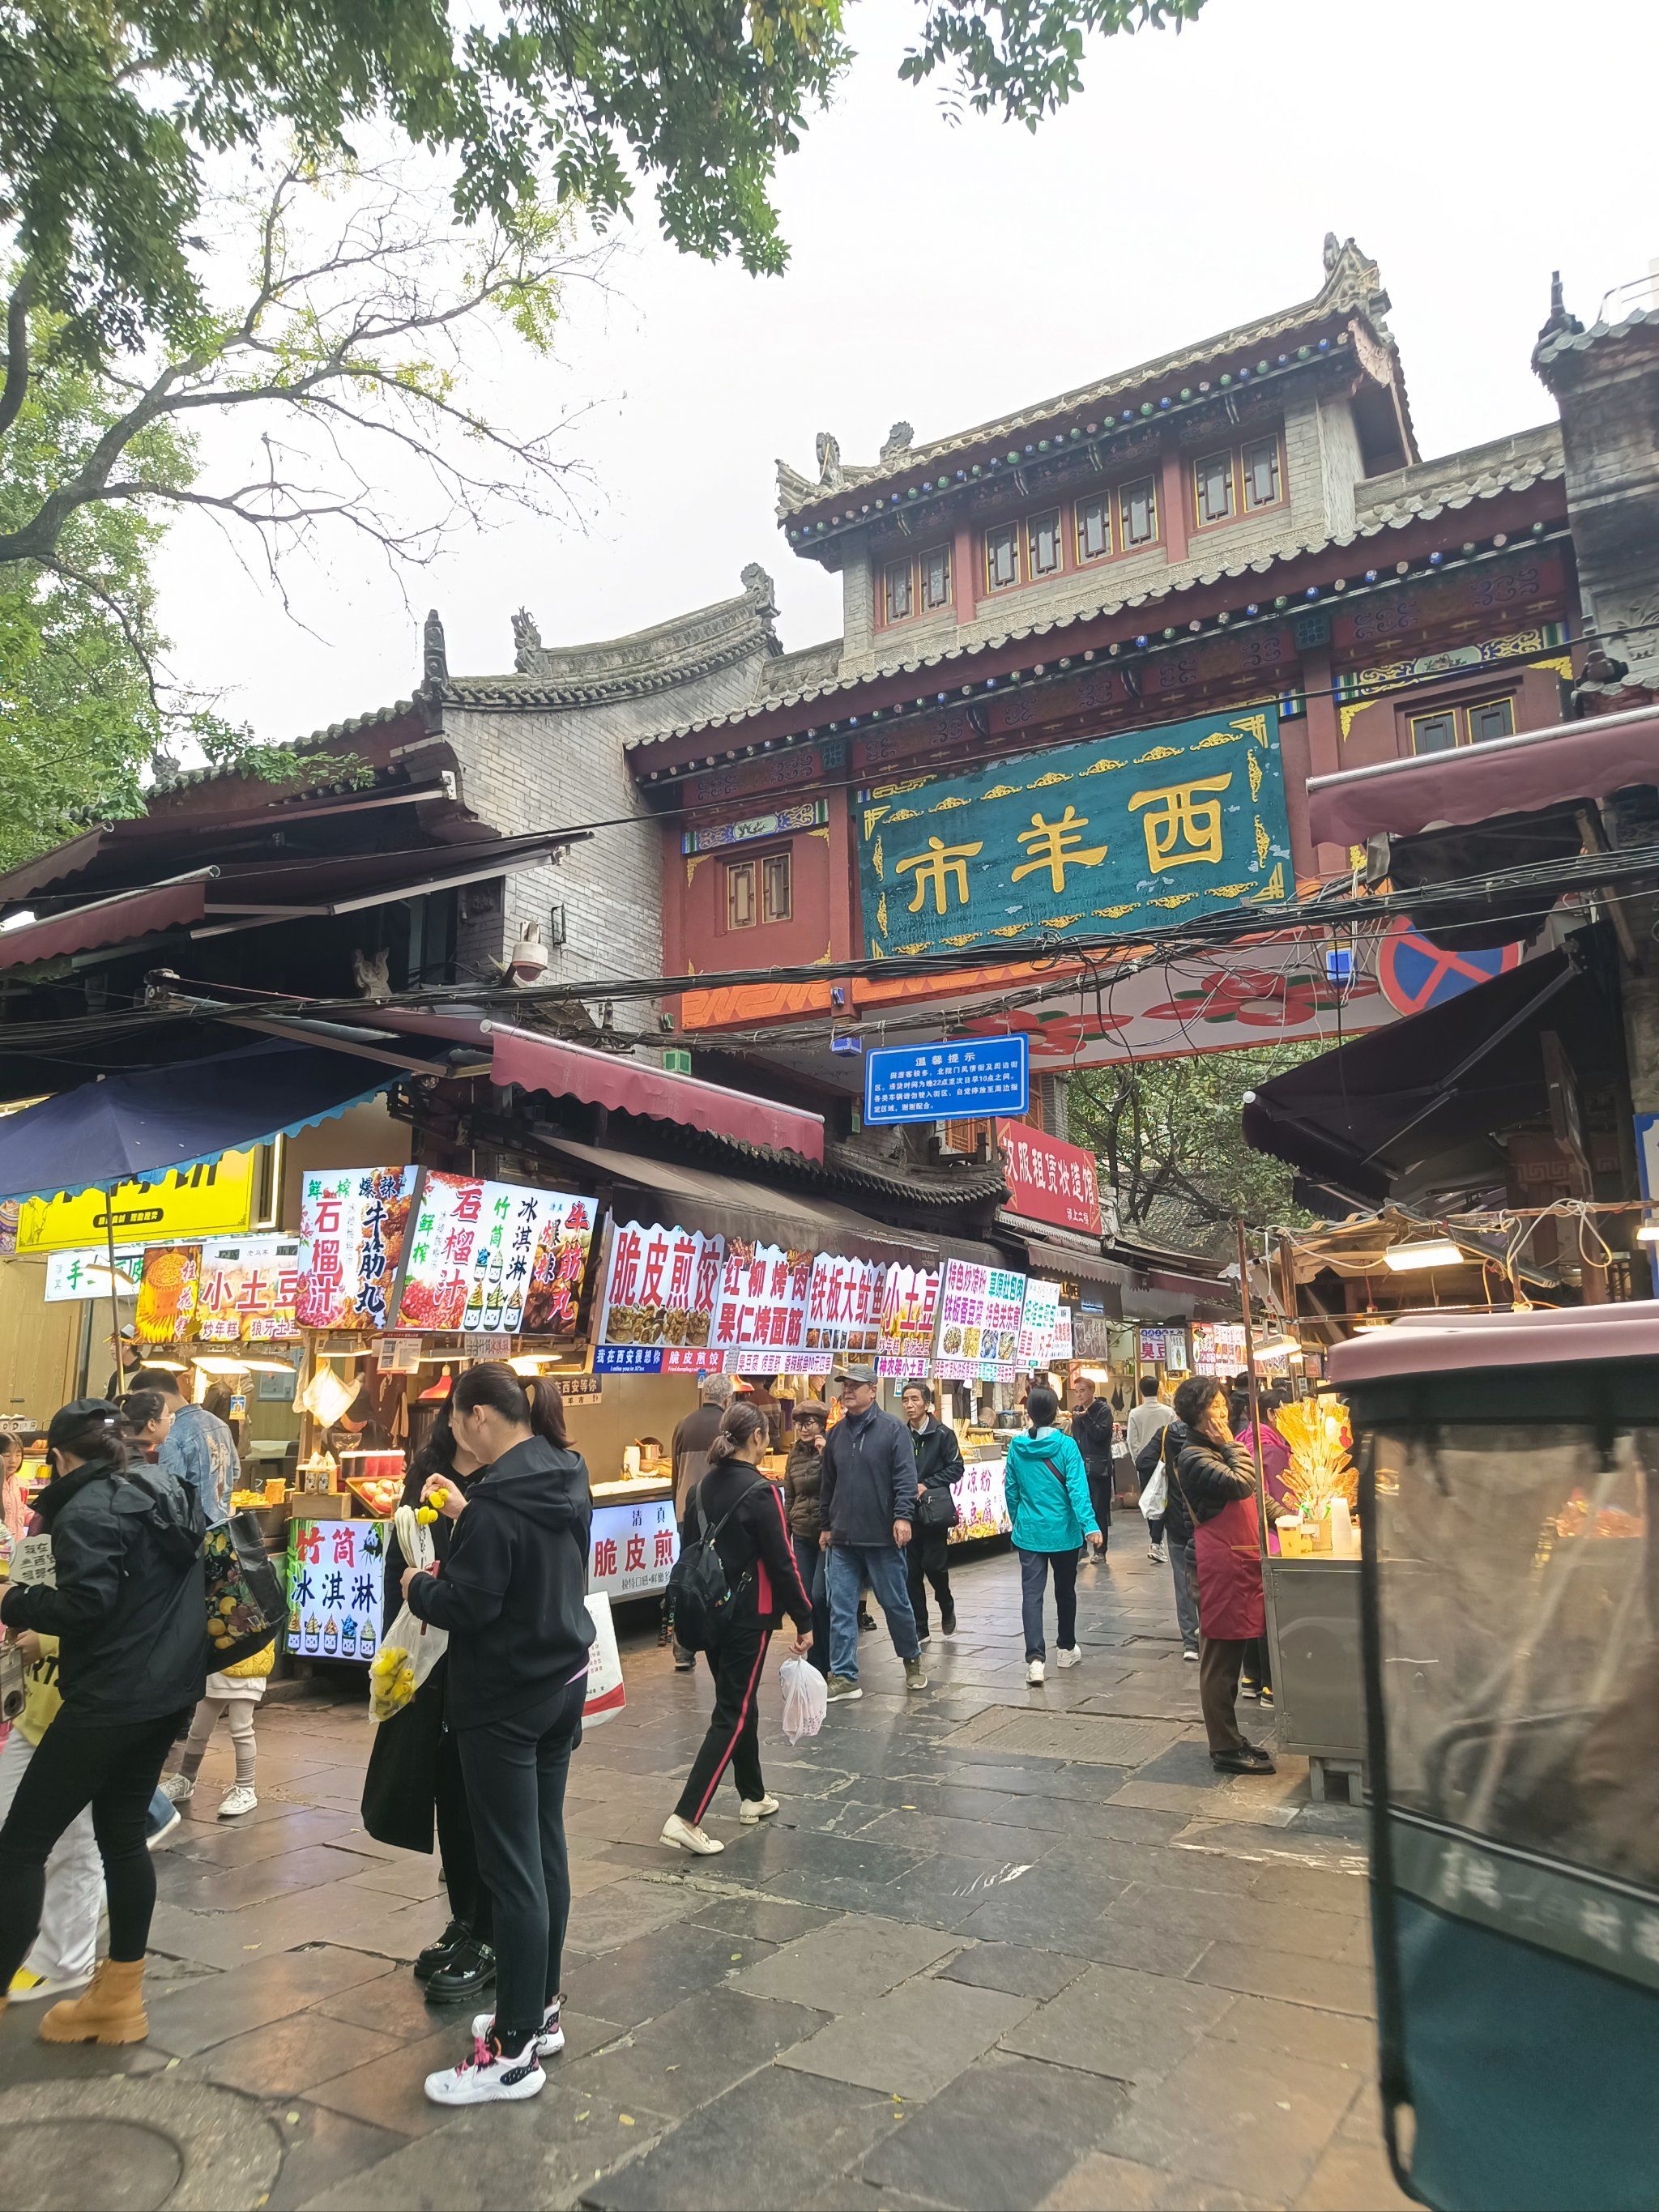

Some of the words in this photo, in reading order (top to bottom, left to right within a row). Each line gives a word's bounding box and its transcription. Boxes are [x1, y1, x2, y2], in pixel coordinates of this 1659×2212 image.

[915, 1052, 975, 1067] 温馨提示
[308, 1178, 351, 1200] 鲜榨
[359, 1176, 396, 1199] 爆辣
[412, 1213, 435, 1265] 鲜榨
[489, 1195, 510, 1248] 竹筒
[505, 1197, 538, 1281] 冰淇淋
[309, 1201, 343, 1315] 石榴汁
[354, 1200, 387, 1314] 牛筋丸
[433, 1188, 483, 1308] 石榴汁
[535, 1218, 561, 1284] 爆辣
[547, 1201, 590, 1321] 牛筋丸
[202, 1269, 298, 1311] 小土豆
[608, 1229, 721, 1316] 脆皮煎饺
[723, 1256, 811, 1301] 红柳烤肉
[810, 1262, 886, 1325] 铁板大鱿鱼
[883, 1271, 939, 1332] 小土豆
[203, 1319, 239, 1338] 炒年糕
[251, 1318, 301, 1337] 狼牙土豆
[716, 1302, 805, 1348] 果仁烤面筋
[596, 1349, 661, 1364] 我在西安很想你
[668, 1350, 719, 1366] 脆皮煎饺
[633, 1507, 665, 1526] 清真
[295, 1526, 356, 1568] 竹筒
[594, 1528, 674, 1579] 脆皮煎
[291, 1570, 377, 1613] 冰淇淋
